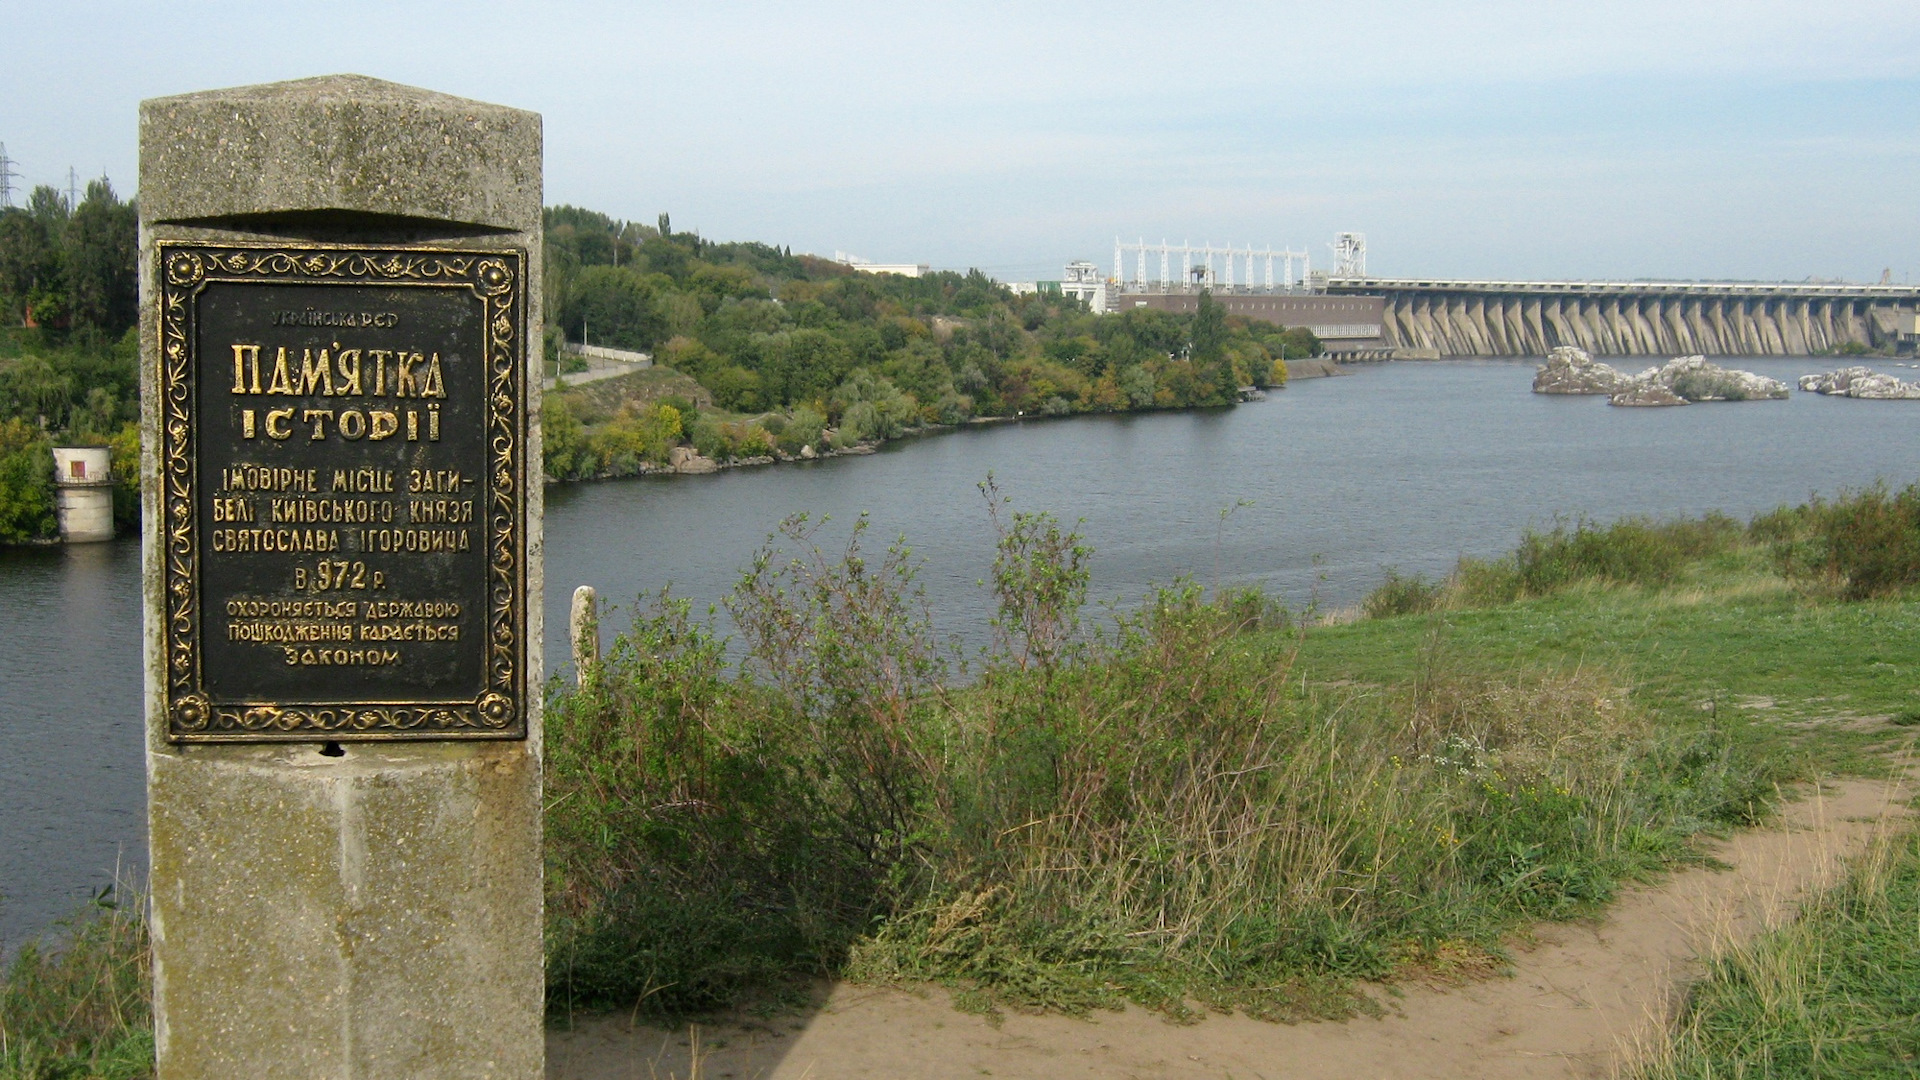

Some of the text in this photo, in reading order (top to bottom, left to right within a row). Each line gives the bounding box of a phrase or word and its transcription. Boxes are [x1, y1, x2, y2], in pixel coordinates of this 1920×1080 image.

[242, 403, 441, 441] ІСТОРІЇ
[222, 468, 474, 493] ІМОВІРНЕ МІСЦЕ ЗАГИ-
[271, 495, 393, 523] КИЇВСЬКОГО
[410, 500, 473, 523] КНЯЗЯ
[213, 529, 470, 553] СВЯТОСЛАВА ІГОРОВИЧА
[318, 561, 366, 589] 972
[226, 601, 460, 619] ОХОРОНЯЄТЬСЯ ДЕРЖАВОЮ
[228, 624, 459, 642] ПОШКОДЖЕННЯ КАРАЄТЬСЯ
[285, 647, 403, 666] ЗАКОНОМ
